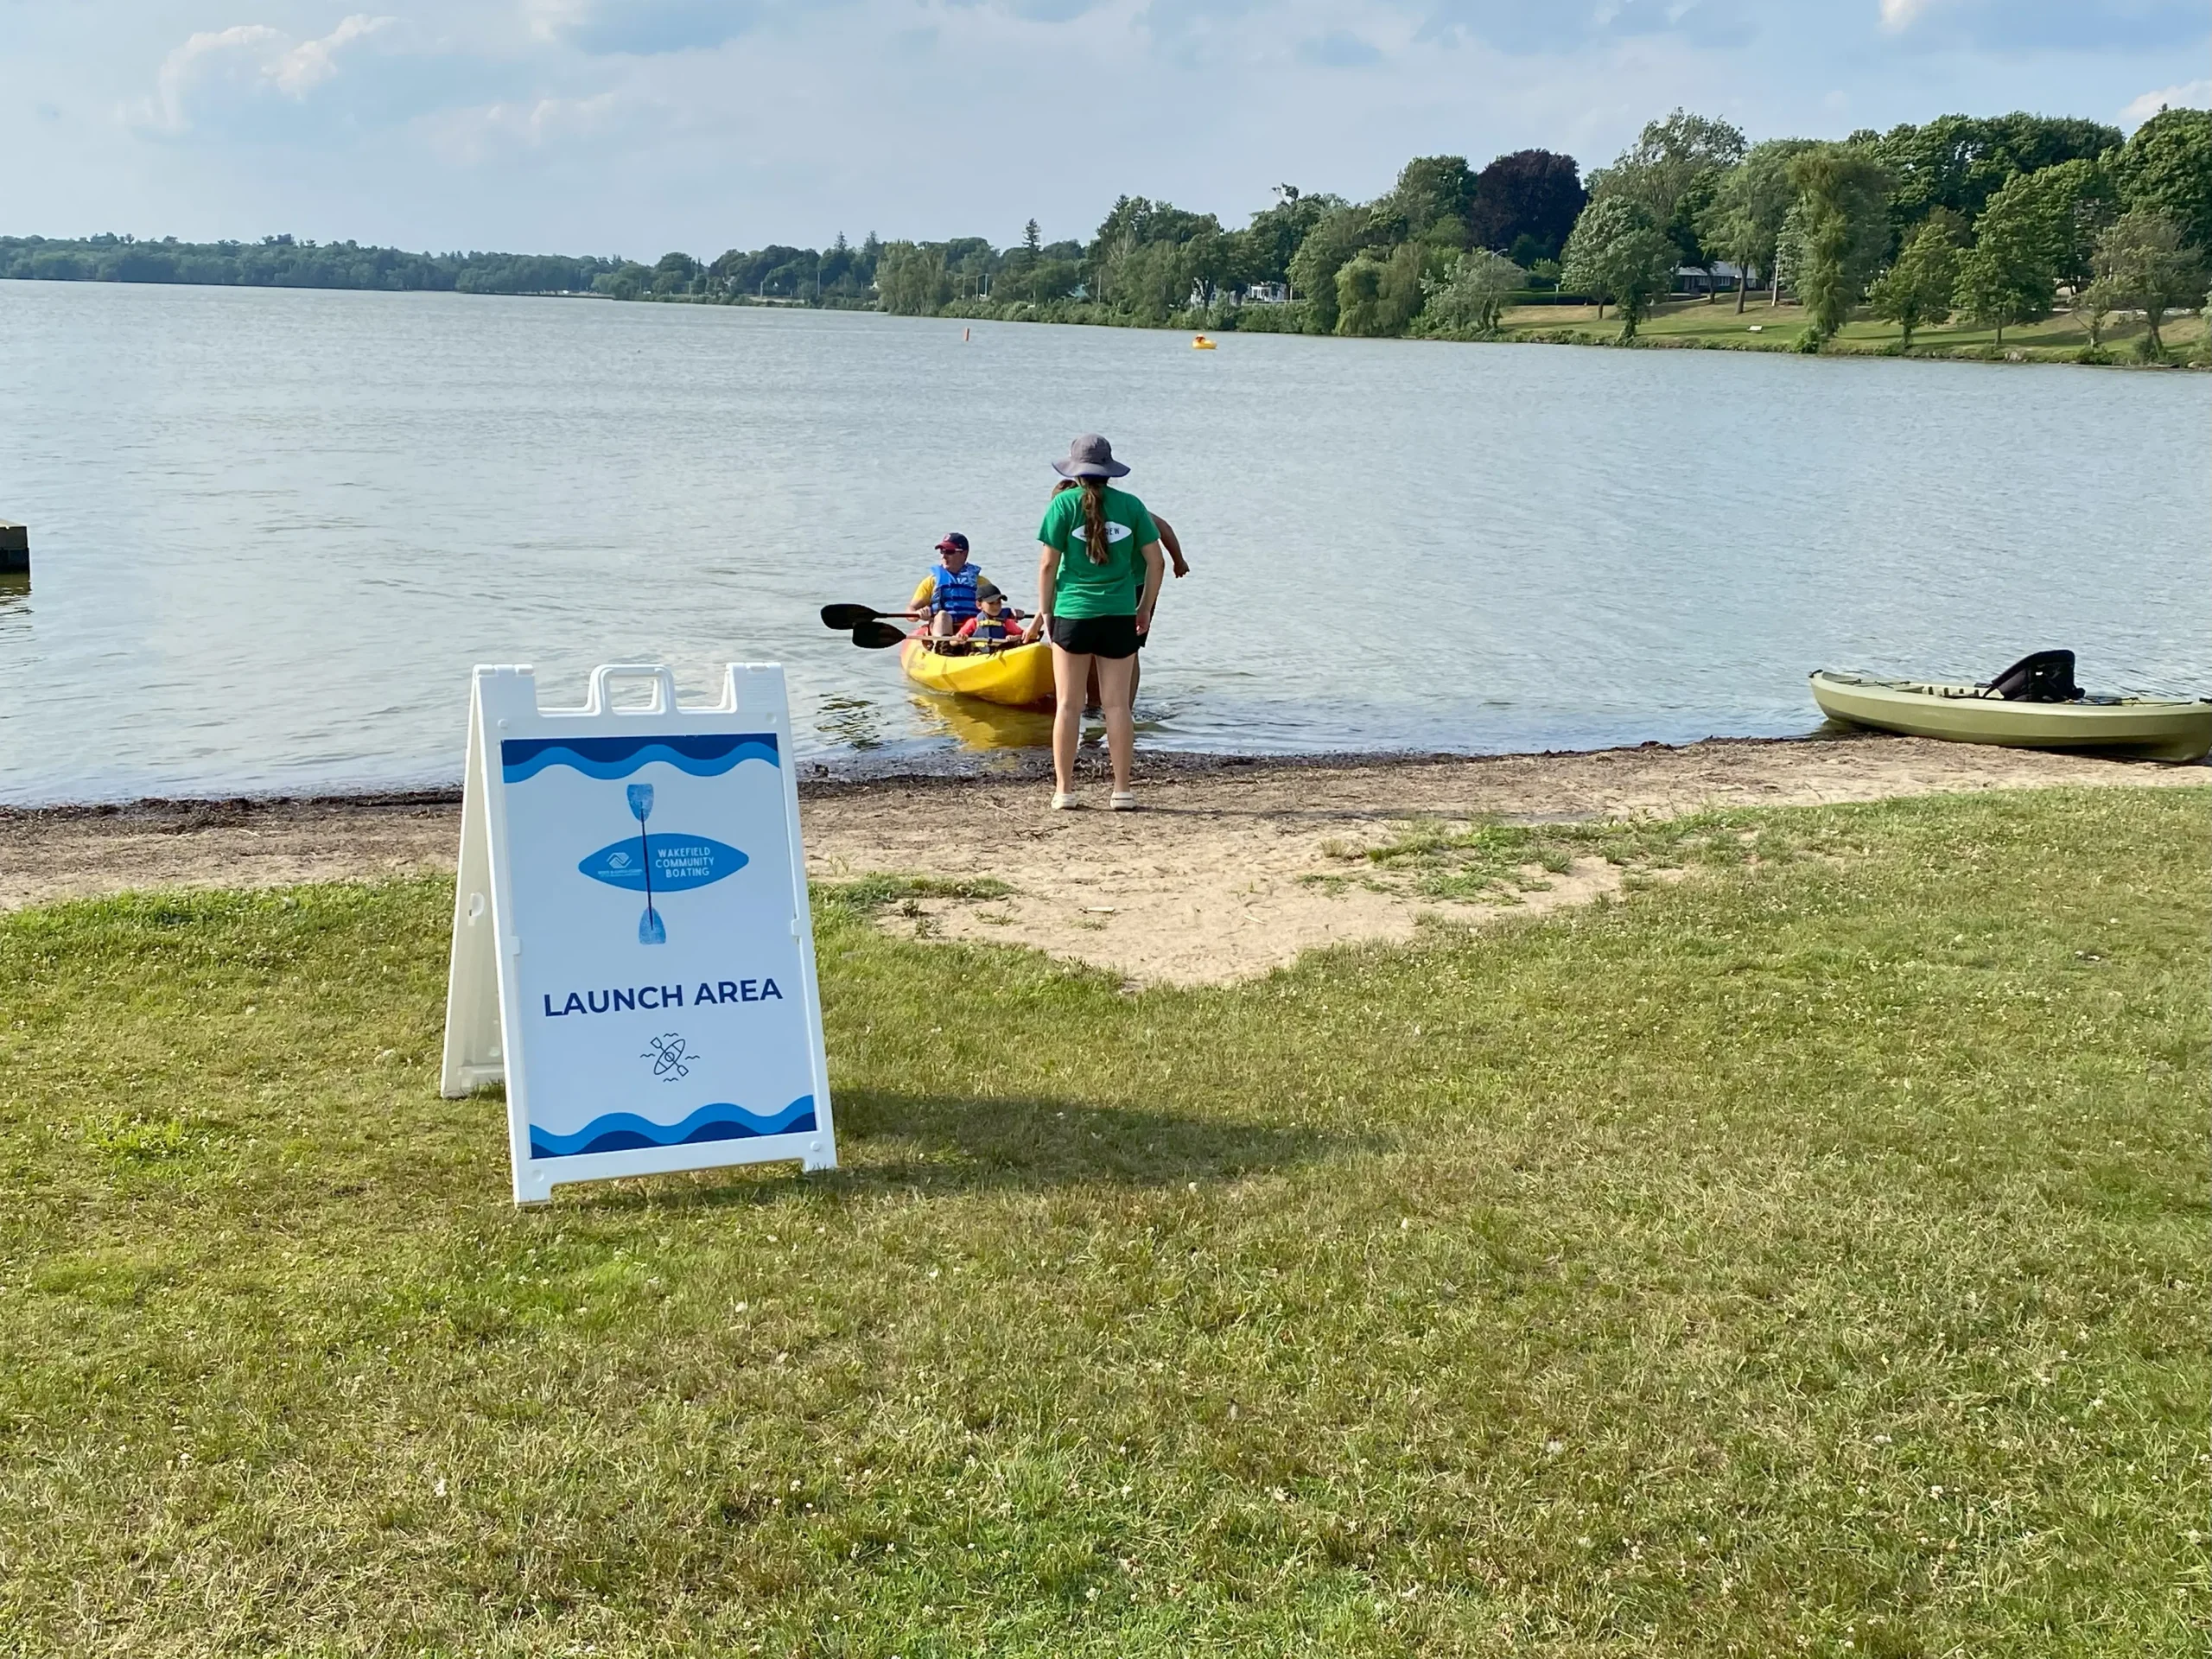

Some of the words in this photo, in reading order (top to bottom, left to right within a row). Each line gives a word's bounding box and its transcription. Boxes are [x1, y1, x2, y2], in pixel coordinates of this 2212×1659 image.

[658, 847, 710, 858] WAKEFIELD
[655, 856, 715, 868] COMMUNITY
[665, 867, 710, 878] BOATING
[543, 984, 683, 1017] LAUNCH
[694, 978, 784, 1006] AREA
